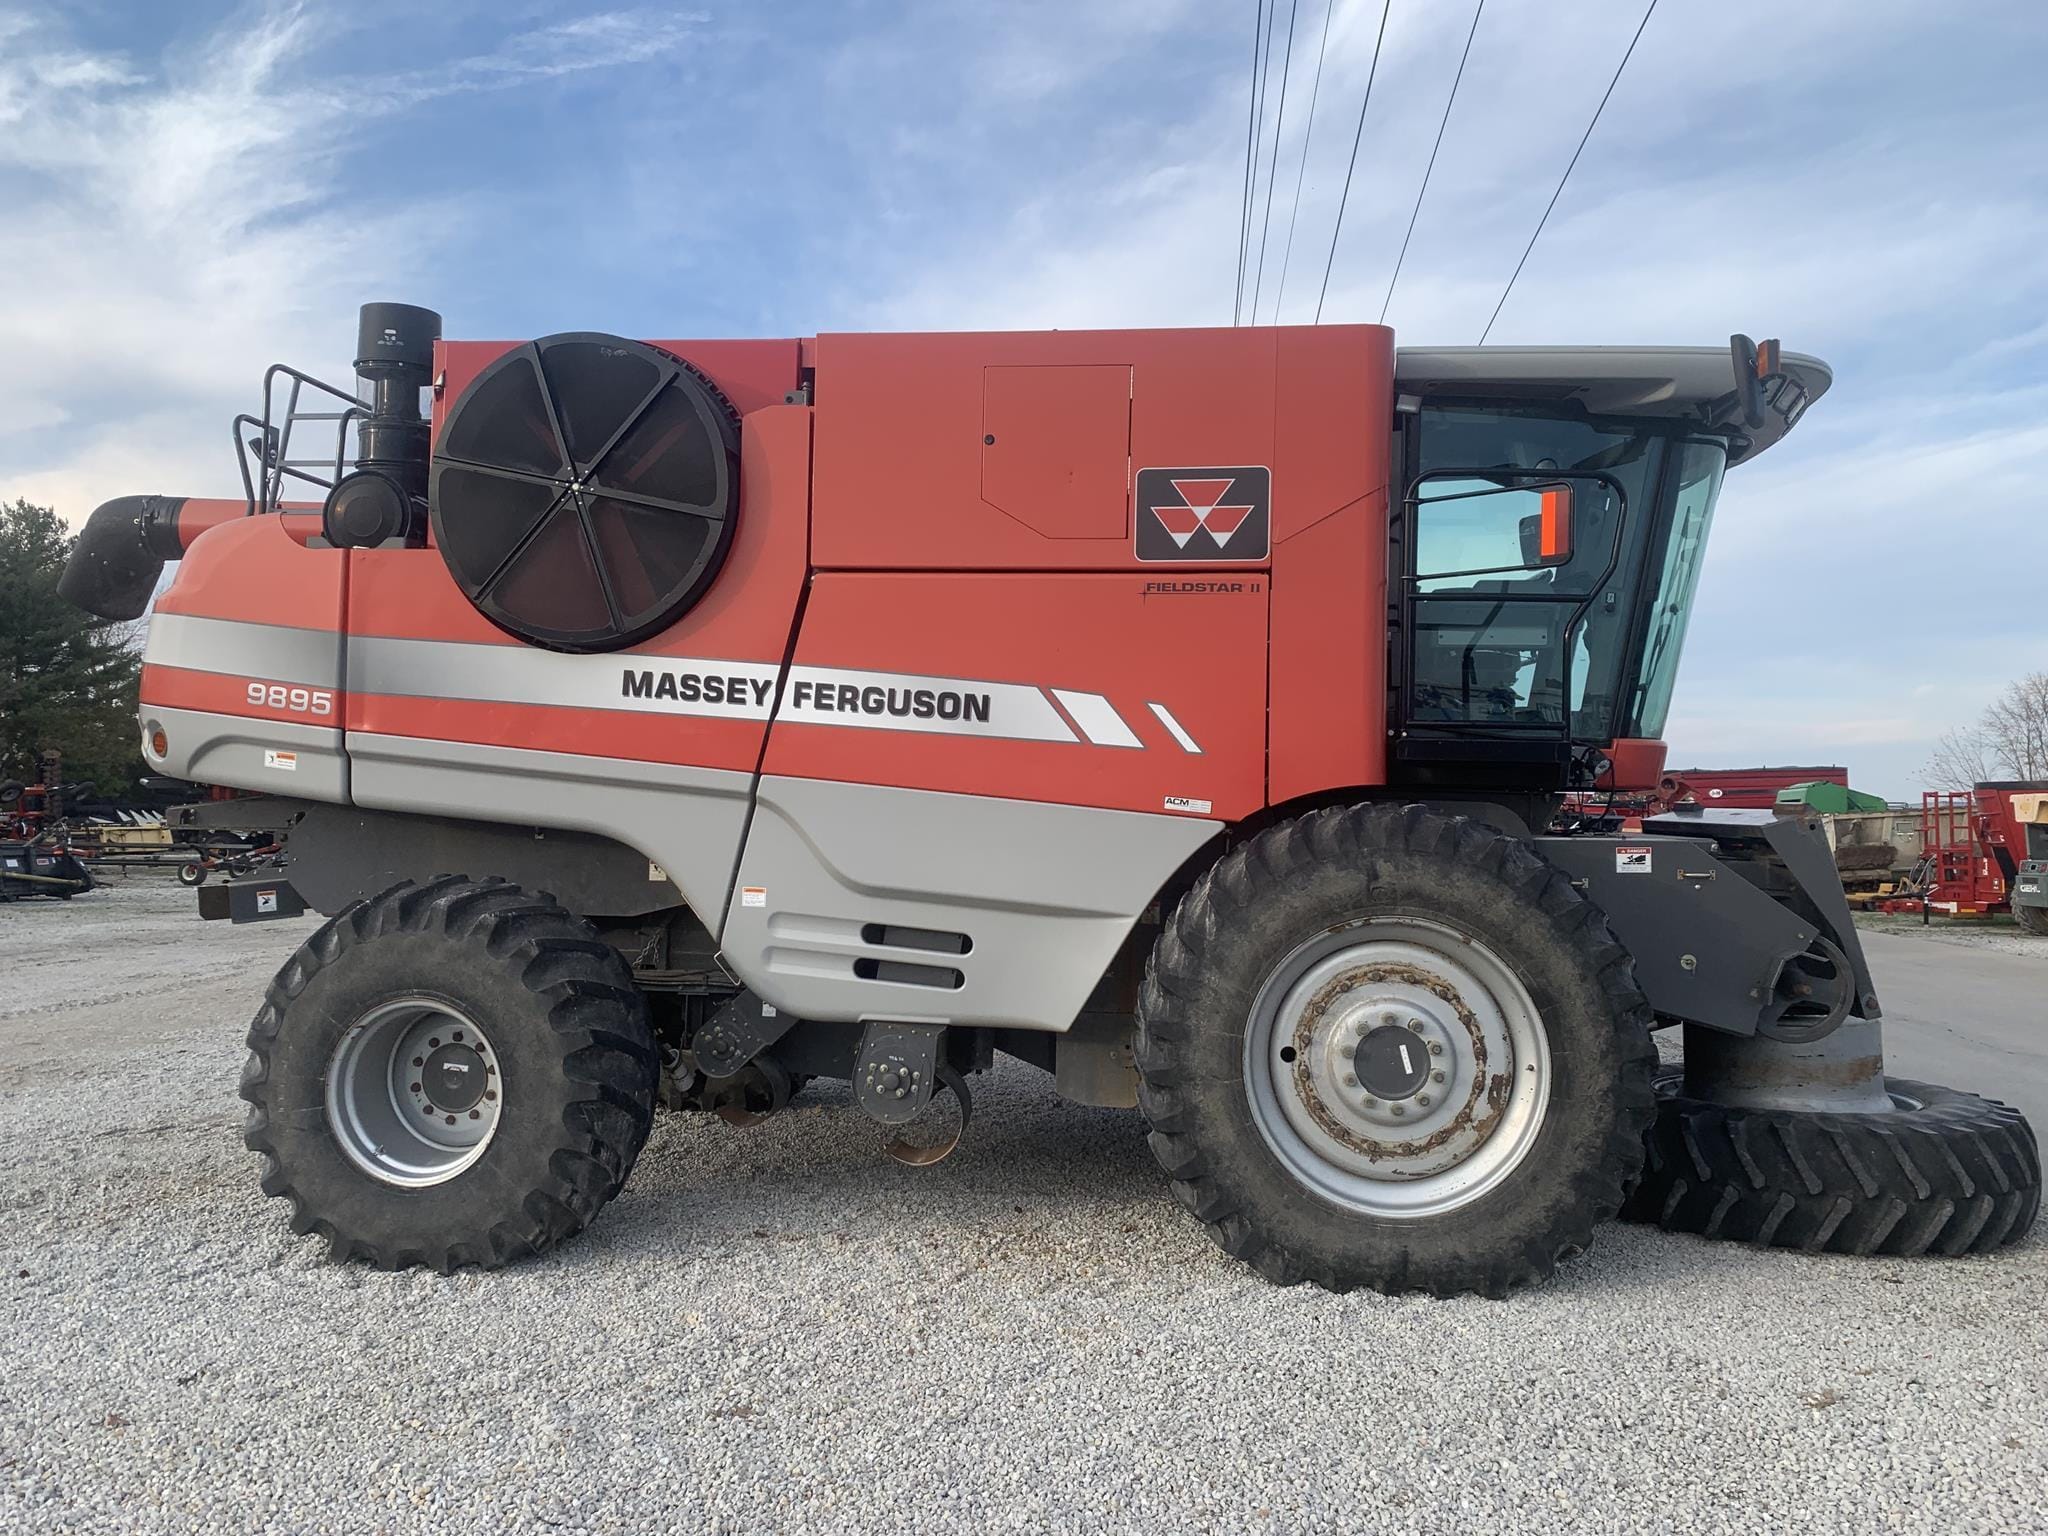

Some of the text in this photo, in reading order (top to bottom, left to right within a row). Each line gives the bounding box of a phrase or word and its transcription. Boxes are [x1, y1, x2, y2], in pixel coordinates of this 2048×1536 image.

[1146, 582, 1260, 593] FIELDSTAR II
[247, 682, 332, 715] 9895
[622, 669, 991, 722] MASSEY FERGUSON
[1166, 797, 1190, 806] ACM
[2020, 884, 2041, 893] GEHL
